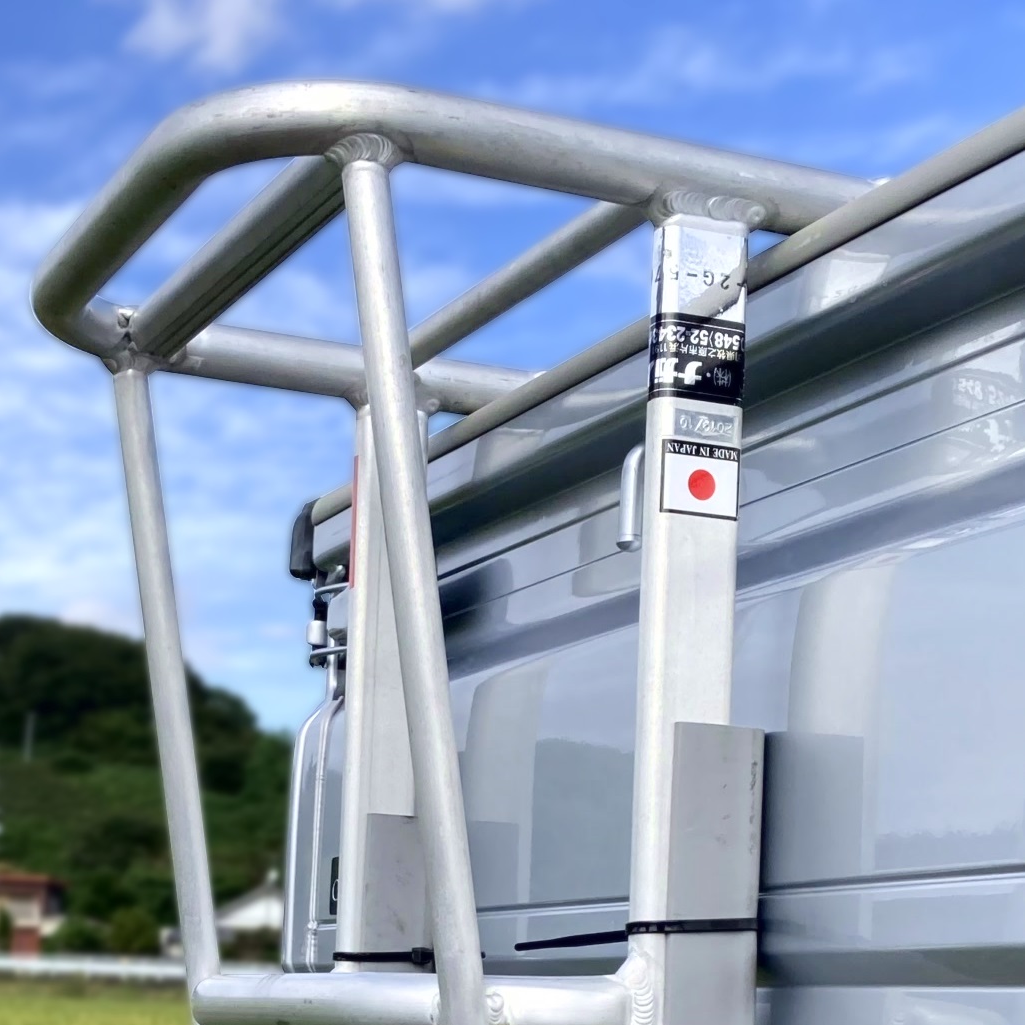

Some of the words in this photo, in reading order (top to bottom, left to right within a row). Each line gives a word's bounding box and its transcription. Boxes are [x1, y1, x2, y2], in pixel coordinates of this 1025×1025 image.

[667, 442, 697, 455] JAPAN
[699, 446, 710, 457] IN
[713, 448, 738, 461] MADE
